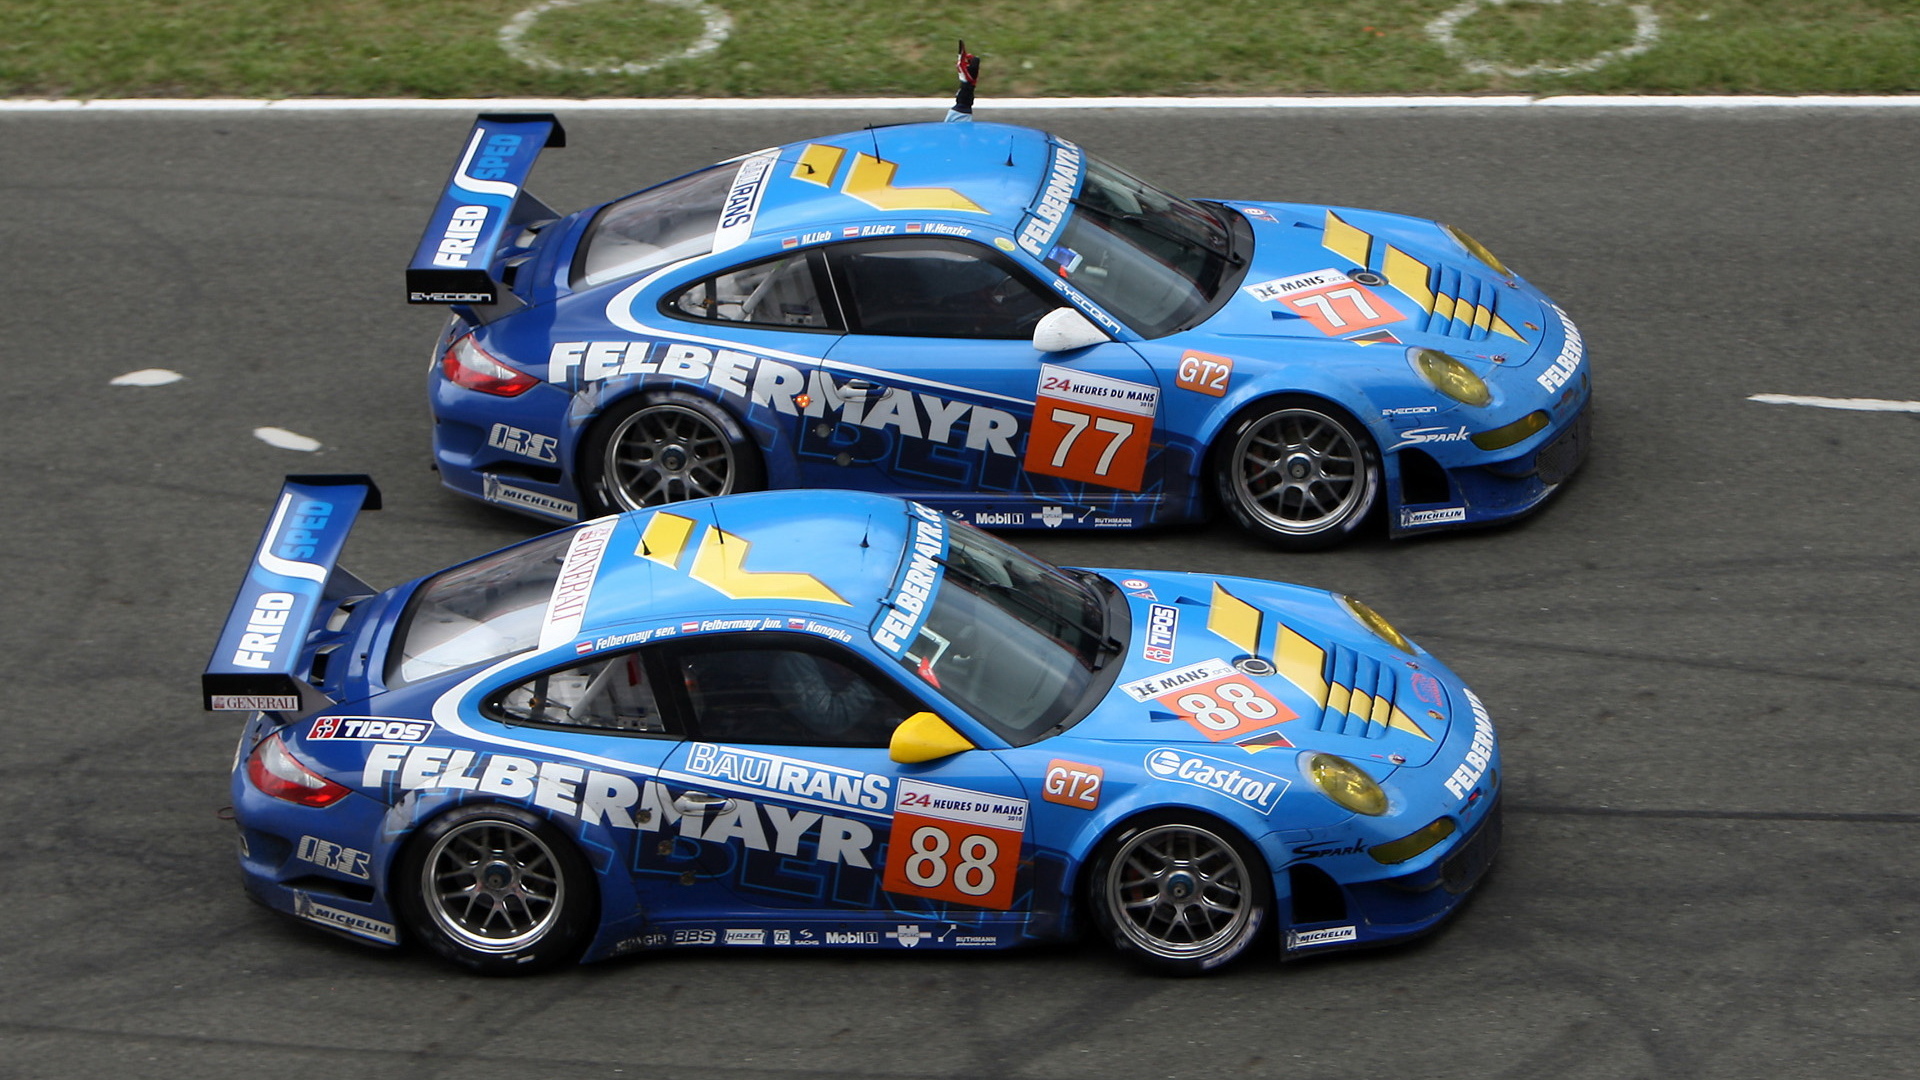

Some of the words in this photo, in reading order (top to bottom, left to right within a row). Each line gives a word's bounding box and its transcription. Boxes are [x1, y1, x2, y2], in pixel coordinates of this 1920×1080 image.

[433, 205, 488, 267] FRIED
[473, 134, 522, 180] SPED
[801, 231, 832, 245] M.Lieb
[861, 225, 896, 237] R.Lietz
[923, 223, 972, 237] W.Henzler
[1280, 276, 1325, 292] MANS
[1292, 287, 1381, 327] 77
[1179, 355, 1230, 391] GT2
[549, 341, 1018, 457] FELBERMAYR
[1043, 377, 1071, 392] 24
[1072, 384, 1107, 397] HEURES
[1110, 389, 1125, 399] DU
[1126, 391, 1155, 403] MANS
[1050, 408, 1135, 476] 77
[503, 489, 575, 513] MICHELIN
[976, 513, 1011, 524] Mobil
[1013, 513, 1024, 525] 1
[1414, 509, 1462, 522] MICHELIN
[232, 592, 294, 669] FRIED
[279, 500, 334, 561] SPED
[551, 539, 605, 624] GENERALI
[701, 620, 760, 632] Felbermayr
[762, 618, 782, 631] jun.
[806, 620, 852, 643] Konopka
[1150, 607, 1175, 646] TIPOS
[595, 631, 653, 651] Felbermayr
[655, 626, 676, 637] sen.
[1160, 668, 1209, 690] MANS
[227, 696, 296, 709] GENERALI
[1177, 683, 1278, 731] 88
[345, 721, 425, 739] TIPOS
[684, 741, 890, 810] BAUTRANS
[1044, 766, 1099, 803] GT2
[1178, 755, 1278, 806] Castrol
[362, 744, 872, 869] FELBERMAYR
[901, 792, 931, 807] 24
[933, 799, 972, 811] HEURES
[975, 803, 990, 813] DU
[992, 805, 1024, 816] MANS
[903, 825, 999, 897] 88
[315, 909, 391, 935] MICHELIN
[673, 929, 717, 944] BBS
[727, 933, 762, 941] HAZET
[826, 932, 864, 944] Mobil
[866, 932, 878, 944] 1
[1299, 929, 1353, 942] MICHELIN
